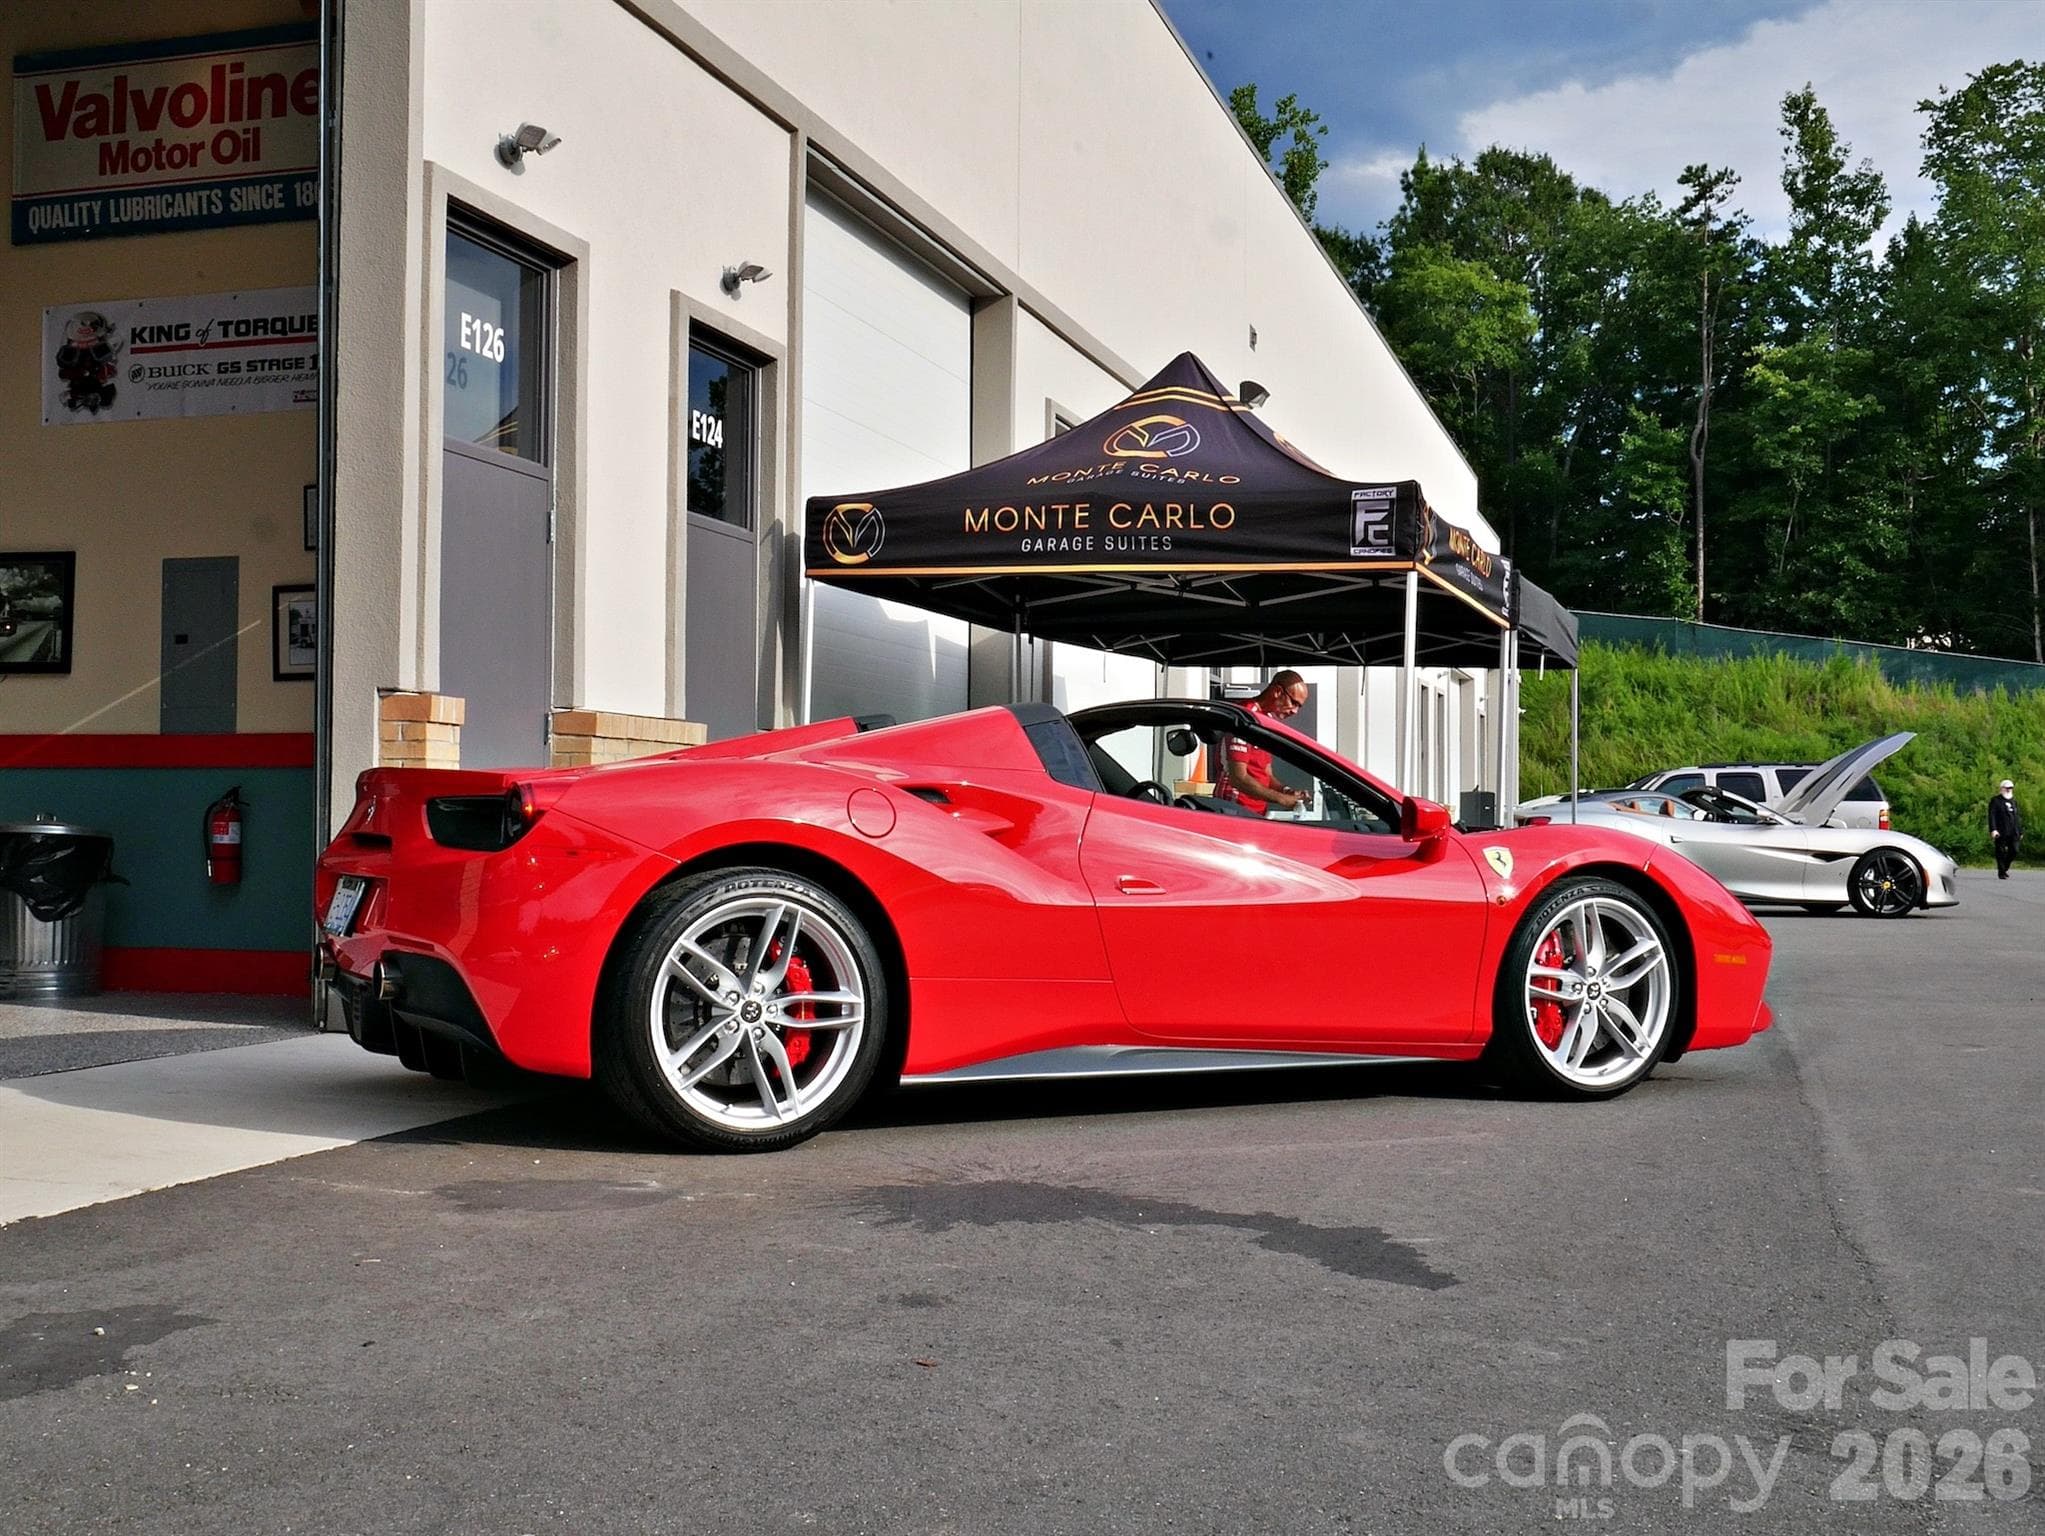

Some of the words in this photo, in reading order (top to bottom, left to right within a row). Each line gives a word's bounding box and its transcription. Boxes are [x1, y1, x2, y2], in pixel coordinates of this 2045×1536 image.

[34, 61, 319, 142] Valvoline
[99, 138, 205, 176] Motor
[210, 126, 261, 166] Oil
[28, 199, 102, 235] QUALITY
[109, 187, 224, 224] LUBRICANTS
[229, 183, 285, 213] SINCE
[130, 322, 191, 345] KING
[195, 318, 215, 345] of
[217, 314, 318, 339] TORQUE
[460, 311, 505, 363] E126
[148, 362, 210, 379] BUICK
[216, 361, 242, 375] GS
[246, 357, 305, 373] STAGE
[691, 409, 724, 449] E124
[1026, 461, 1128, 486] MONTE
[1139, 463, 1242, 485] CARLO
[1066, 469, 1124, 485] GARAGE
[1130, 471, 1187, 485] SUITES
[1353, 489, 1395, 498] FACTORY
[963, 502, 1091, 533] MONTE
[1108, 502, 1237, 529] CARLO
[1021, 535, 1094, 553] GARAGE
[1104, 535, 1173, 551] SUITES
[1471, 543, 1492, 578] CARLO
[1535, 887, 1585, 927] POTENZA
